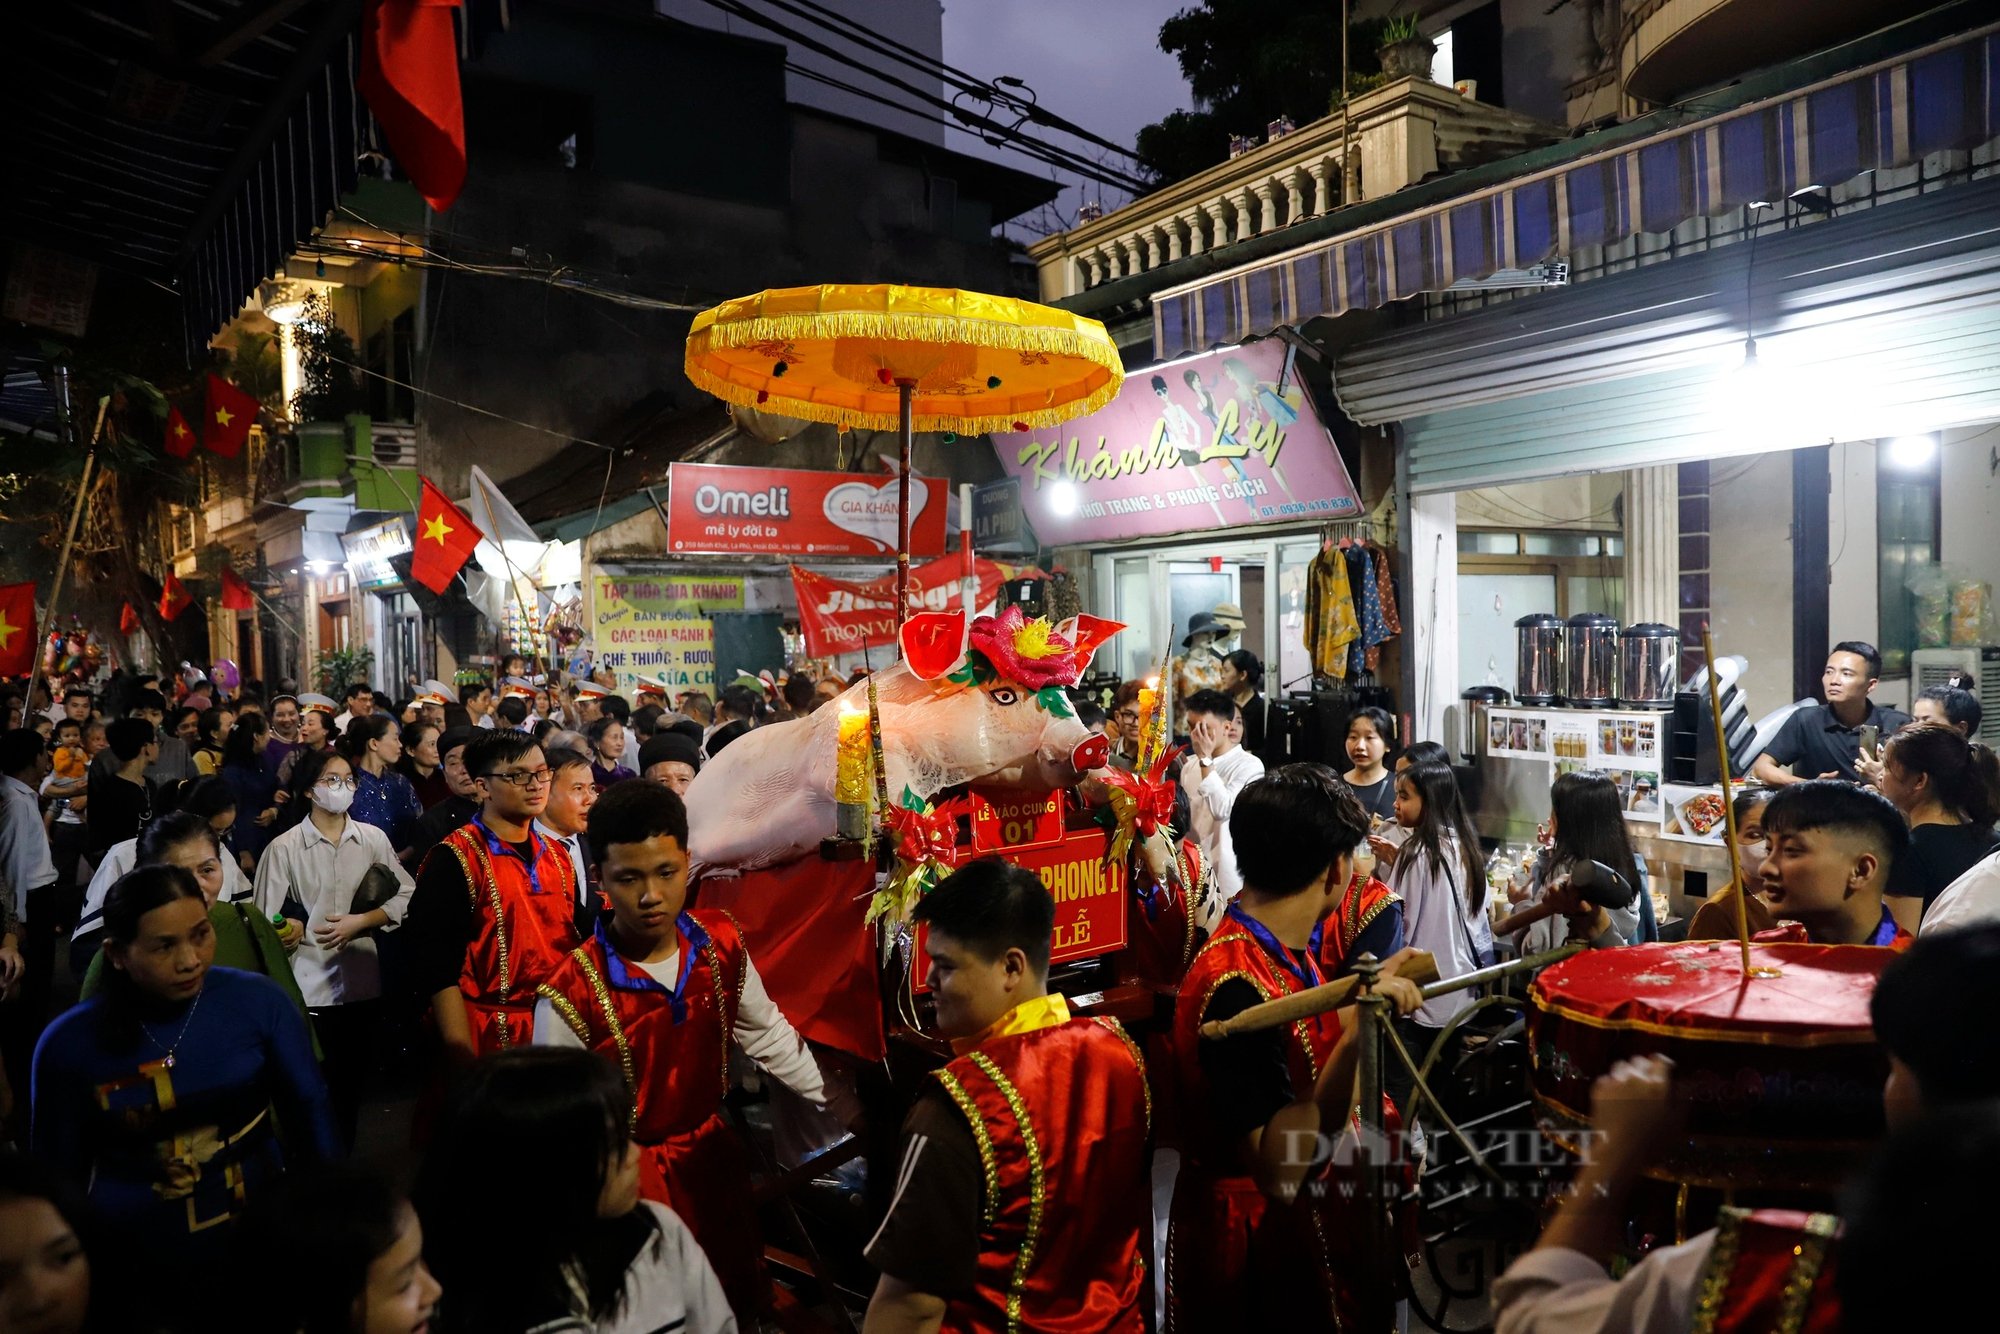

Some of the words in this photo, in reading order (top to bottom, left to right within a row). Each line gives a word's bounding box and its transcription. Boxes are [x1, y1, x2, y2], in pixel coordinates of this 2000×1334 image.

[1017, 417, 1182, 490] Khánh
[1200, 399, 1287, 469] Ly
[695, 485, 791, 519] Omeli
[841, 500, 862, 514] GIA
[865, 499, 899, 514] KHÁN
[1105, 495, 1152, 516] TRANG
[1155, 493, 1167, 510] &
[1167, 486, 1220, 508] PHONG
[1220, 478, 1269, 499] CÁCH
[705, 523, 725, 537] mê
[729, 524, 741, 539] ly
[742, 524, 762, 538] đời
[765, 526, 778, 538] ta
[602, 583, 629, 608] TẠP
[692, 581, 737, 600] KHÁNH
[611, 626, 636, 643] CÁC
[640, 628, 667, 644] LOẠI
[671, 626, 704, 642] BÁNH
[694, 670, 715, 684] CH
[978, 803, 990, 822] LỄ
[993, 804, 1019, 820] VÀO
[1022, 801, 1056, 817] CUNG
[1005, 819, 1034, 843] 01
[1041, 857, 1106, 904] PHONG
[1053, 907, 1091, 949] LỄ
